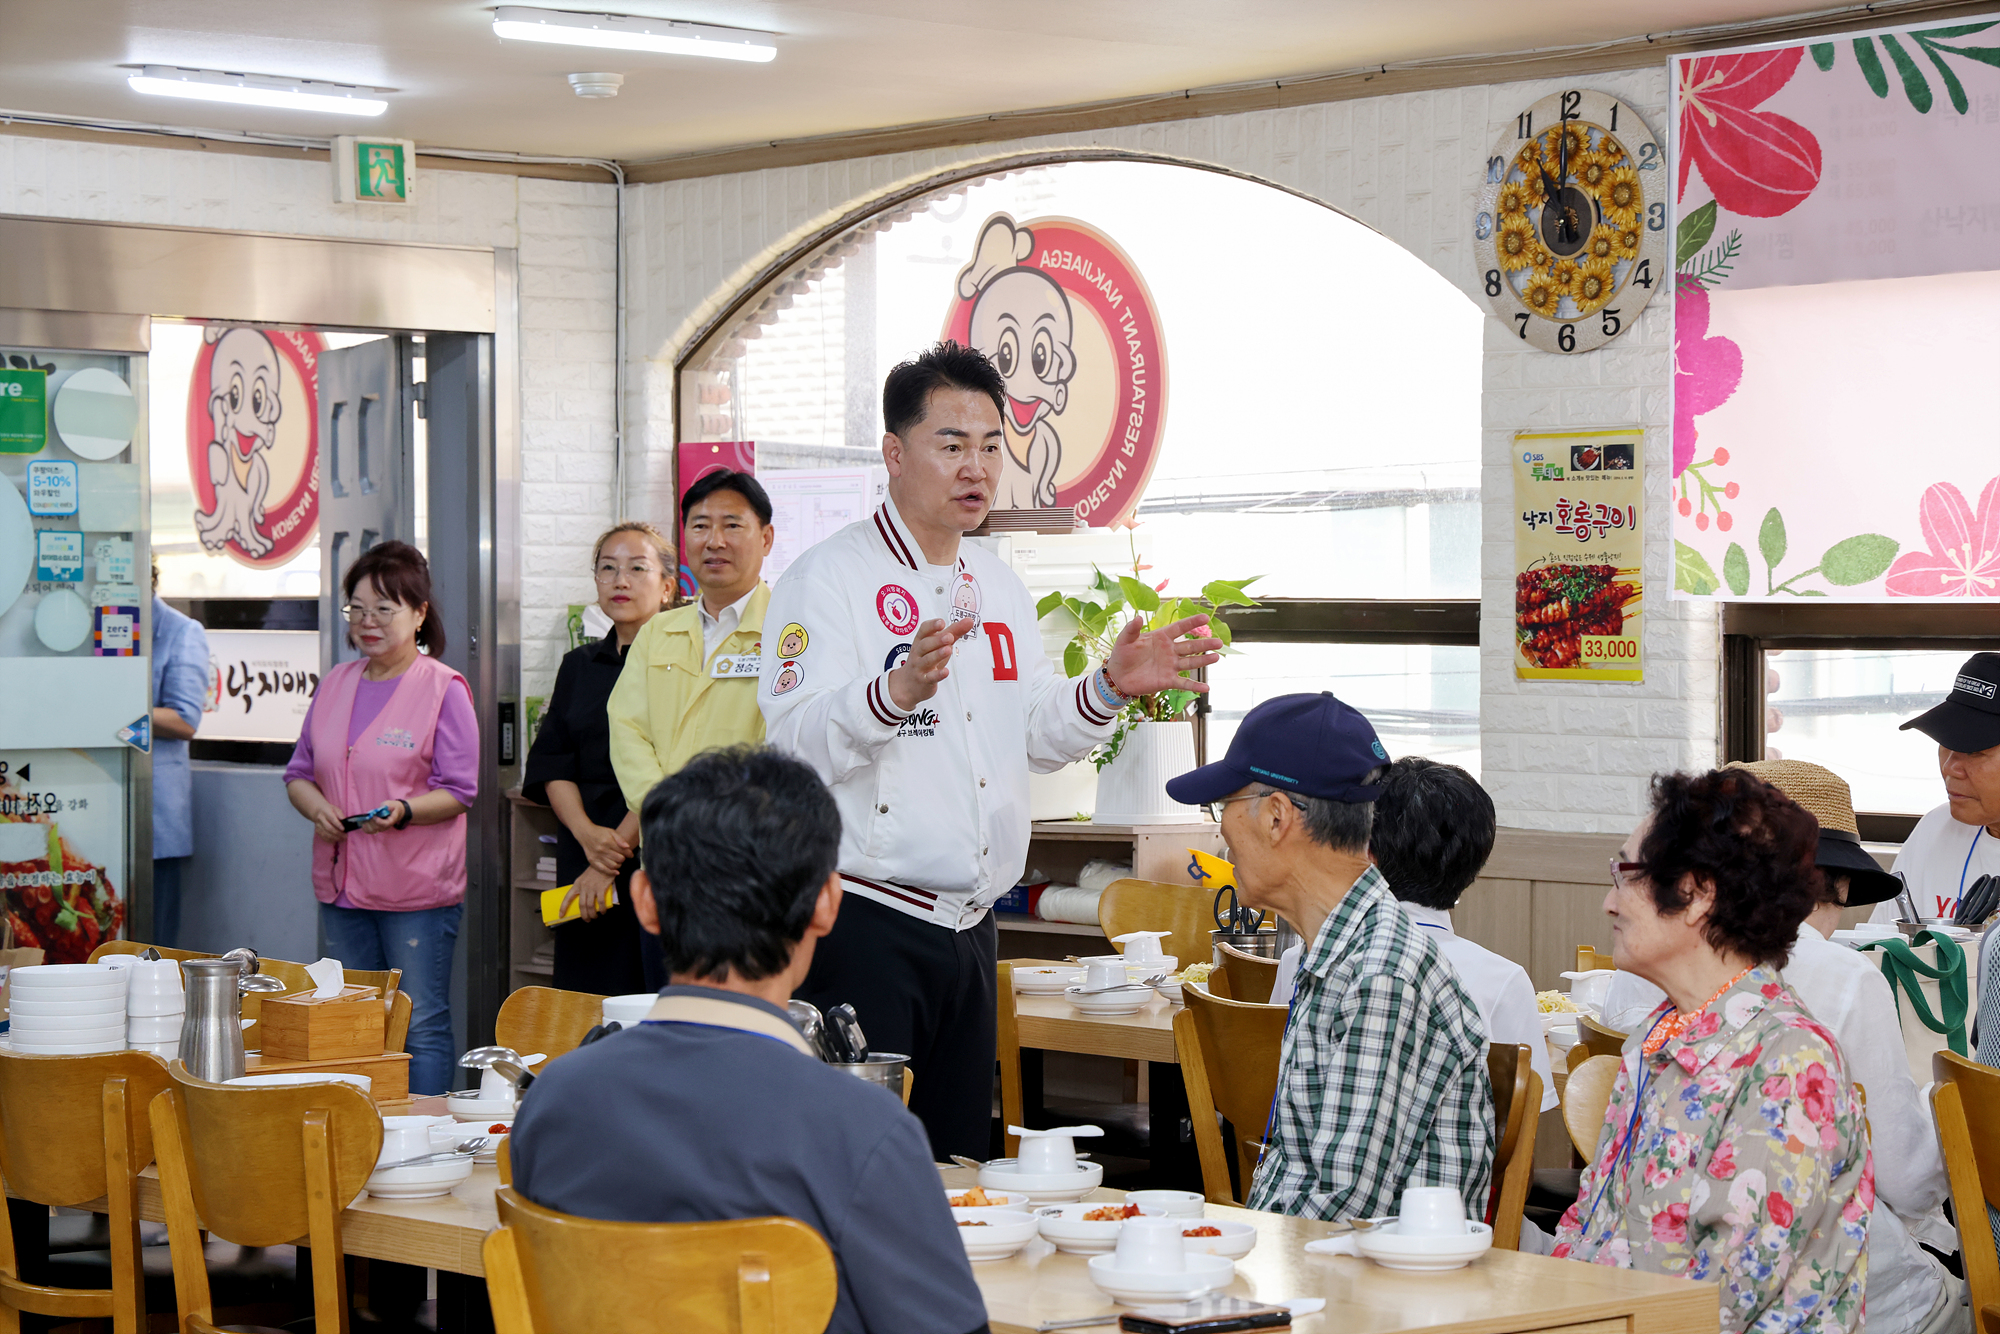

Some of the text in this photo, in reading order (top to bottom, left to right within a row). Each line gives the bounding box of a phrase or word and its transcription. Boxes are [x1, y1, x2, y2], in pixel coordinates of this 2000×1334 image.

[1560, 91, 1581, 121] 12
[1610, 102, 1618, 131] 1
[1517, 111, 1532, 139] 11
[1487, 155, 1505, 184] 10
[1638, 143, 1658, 171] 2
[1475, 212, 1492, 240] 9
[1648, 202, 1665, 232] 3
[1485, 269, 1501, 297] 8
[1633, 259, 1653, 289] 4
[1515, 312, 1531, 339] 7
[1602, 309, 1621, 336] 5
[1558, 324, 1576, 352] 6
[1532, 453, 1544, 461] SBS
[33, 476, 71, 487] 5-10%
[1522, 497, 1636, 542] 낙지 호롱구이
[983, 622, 1018, 683] D
[1584, 640, 1636, 661] 33,000
